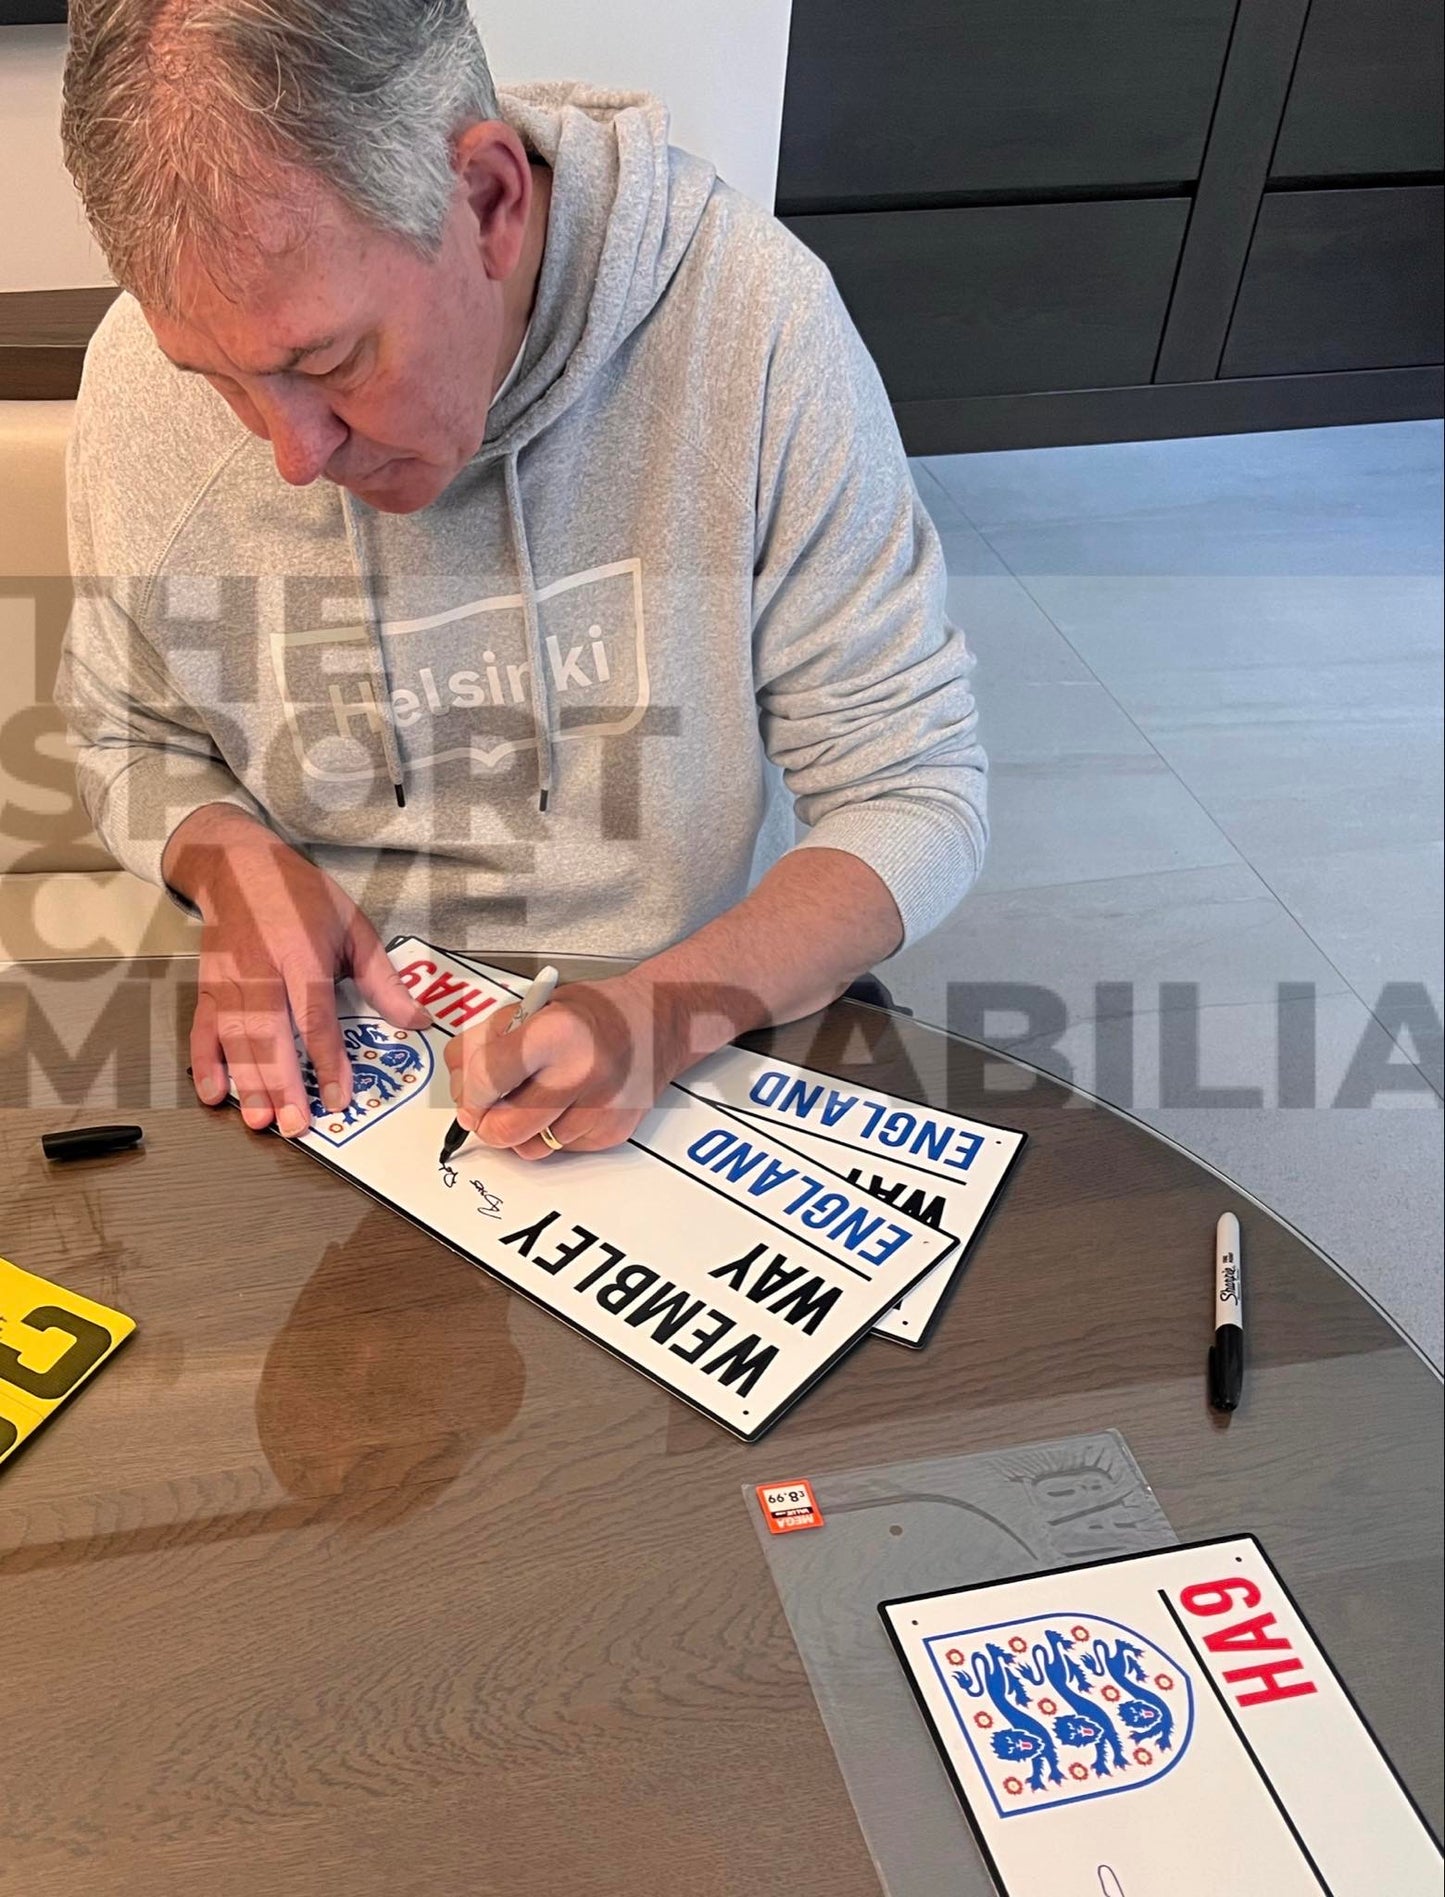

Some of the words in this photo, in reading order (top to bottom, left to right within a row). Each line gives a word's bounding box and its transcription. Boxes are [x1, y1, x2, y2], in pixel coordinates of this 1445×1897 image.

[328, 624, 610, 737] Helsinki
[750, 1071, 985, 1170] ENGLAND
[687, 1129, 912, 1266] ENGLAND
[499, 1211, 780, 1398] WEMBLEY
[709, 1243, 844, 1336] WAY
[1220, 1265, 1238, 1306] Sharpie
[776, 1514, 815, 1528] MEGA
[1180, 1577, 1318, 1707] HA9
